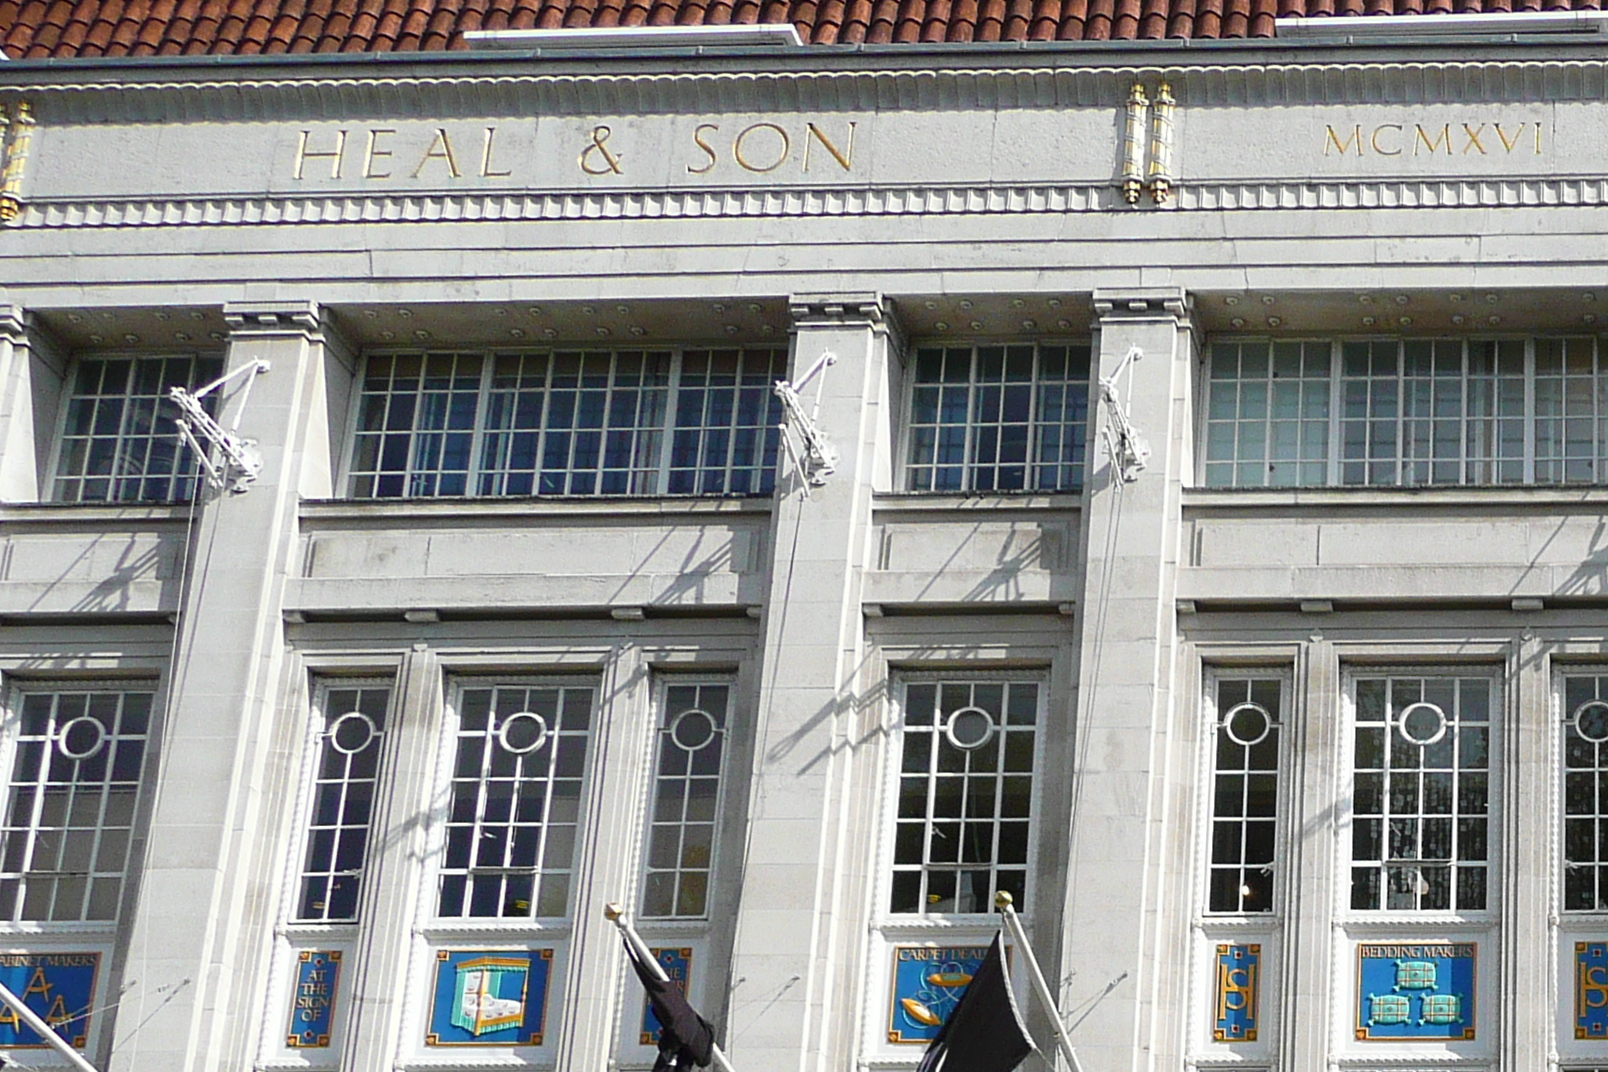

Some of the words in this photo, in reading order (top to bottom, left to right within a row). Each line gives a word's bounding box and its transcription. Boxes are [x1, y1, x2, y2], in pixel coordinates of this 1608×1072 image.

[1323, 122, 1542, 157] MCMXVI
[294, 127, 512, 180] HEAL
[579, 125, 624, 176] &
[686, 122, 858, 175] SON
[900, 948, 947, 961] CARPET
[1361, 945, 1420, 958] BEDDING
[1423, 945, 1473, 958] MAKERS
[46, 955, 97, 966] MAKERS
[305, 969, 328, 982] AT
[300, 983, 328, 995] THE
[296, 996, 331, 1009] SIGN
[301, 1009, 322, 1022] OF
